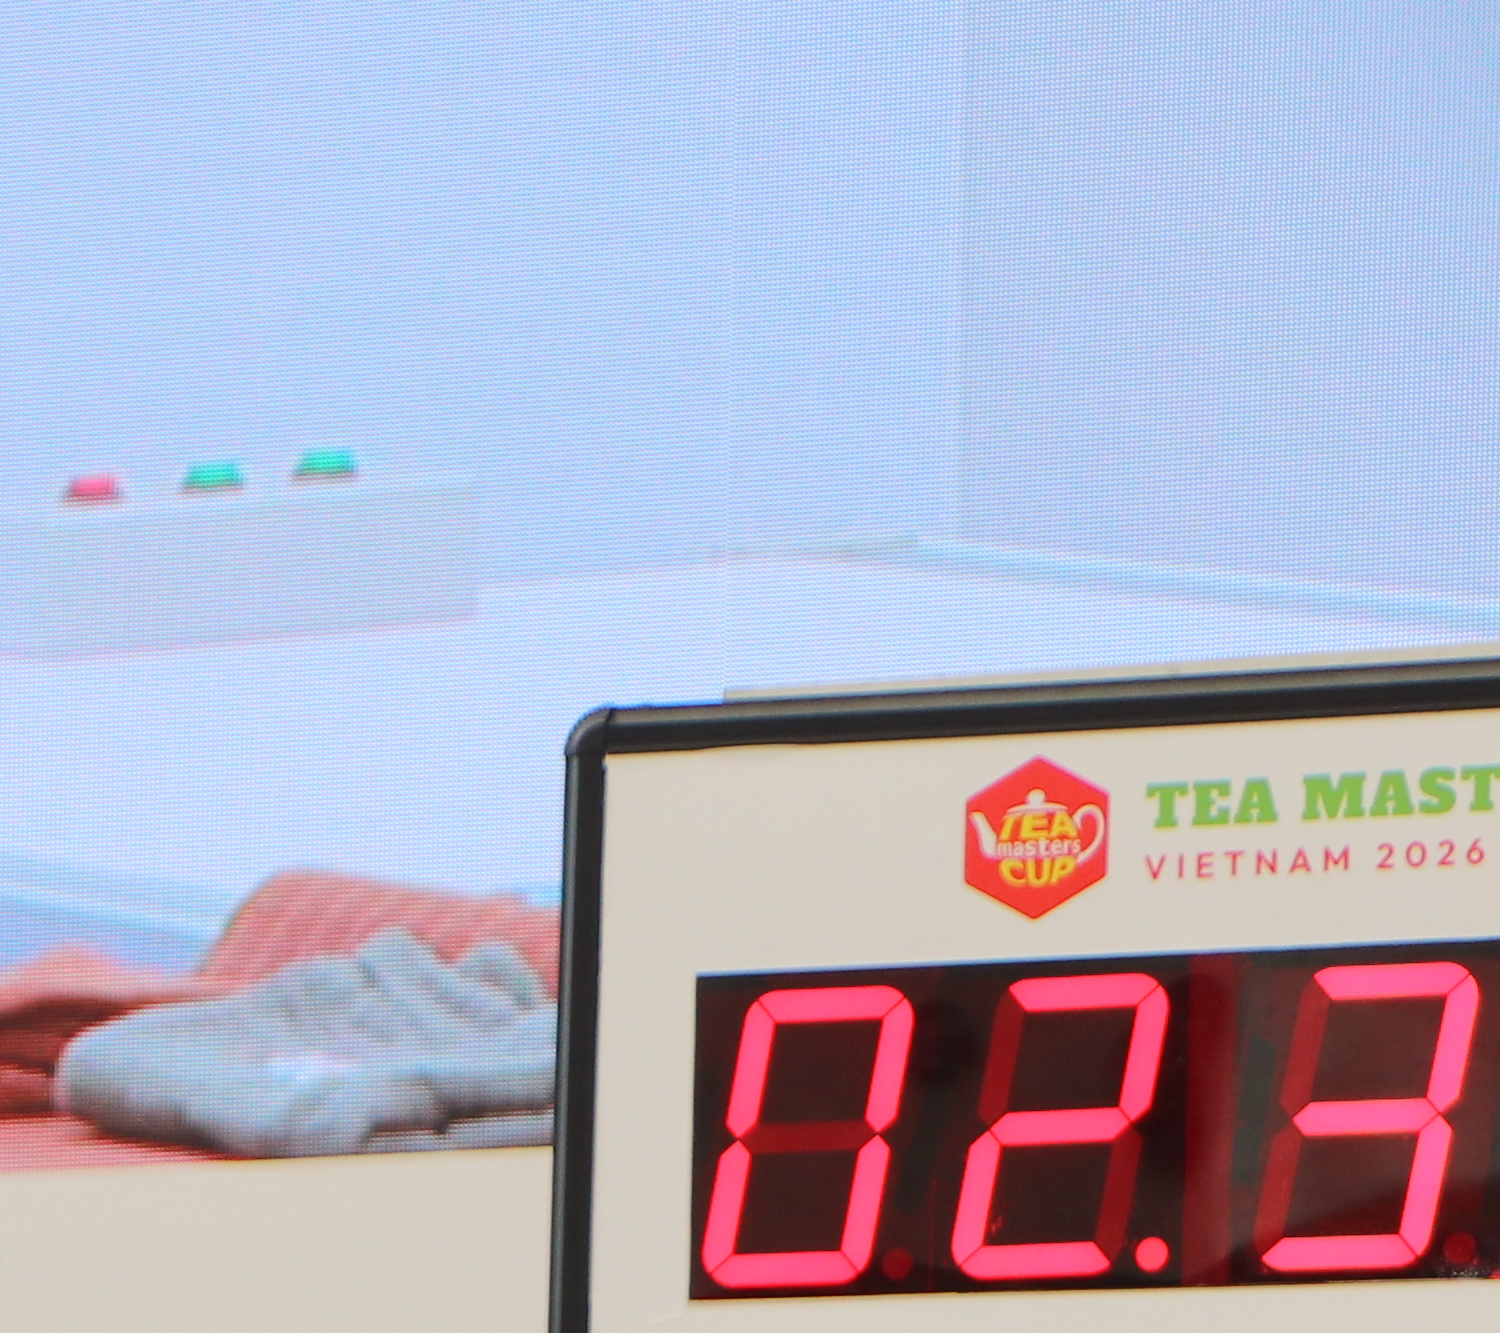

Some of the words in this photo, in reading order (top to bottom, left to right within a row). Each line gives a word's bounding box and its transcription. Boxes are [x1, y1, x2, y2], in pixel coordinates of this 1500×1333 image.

[1146, 776, 1279, 829] TEA
[1001, 811, 1080, 842] TEA
[998, 837, 1082, 857] masters
[1145, 845, 1352, 880] VIETNAM
[1376, 838, 1486, 870] 2026
[999, 854, 1078, 888] CUP
